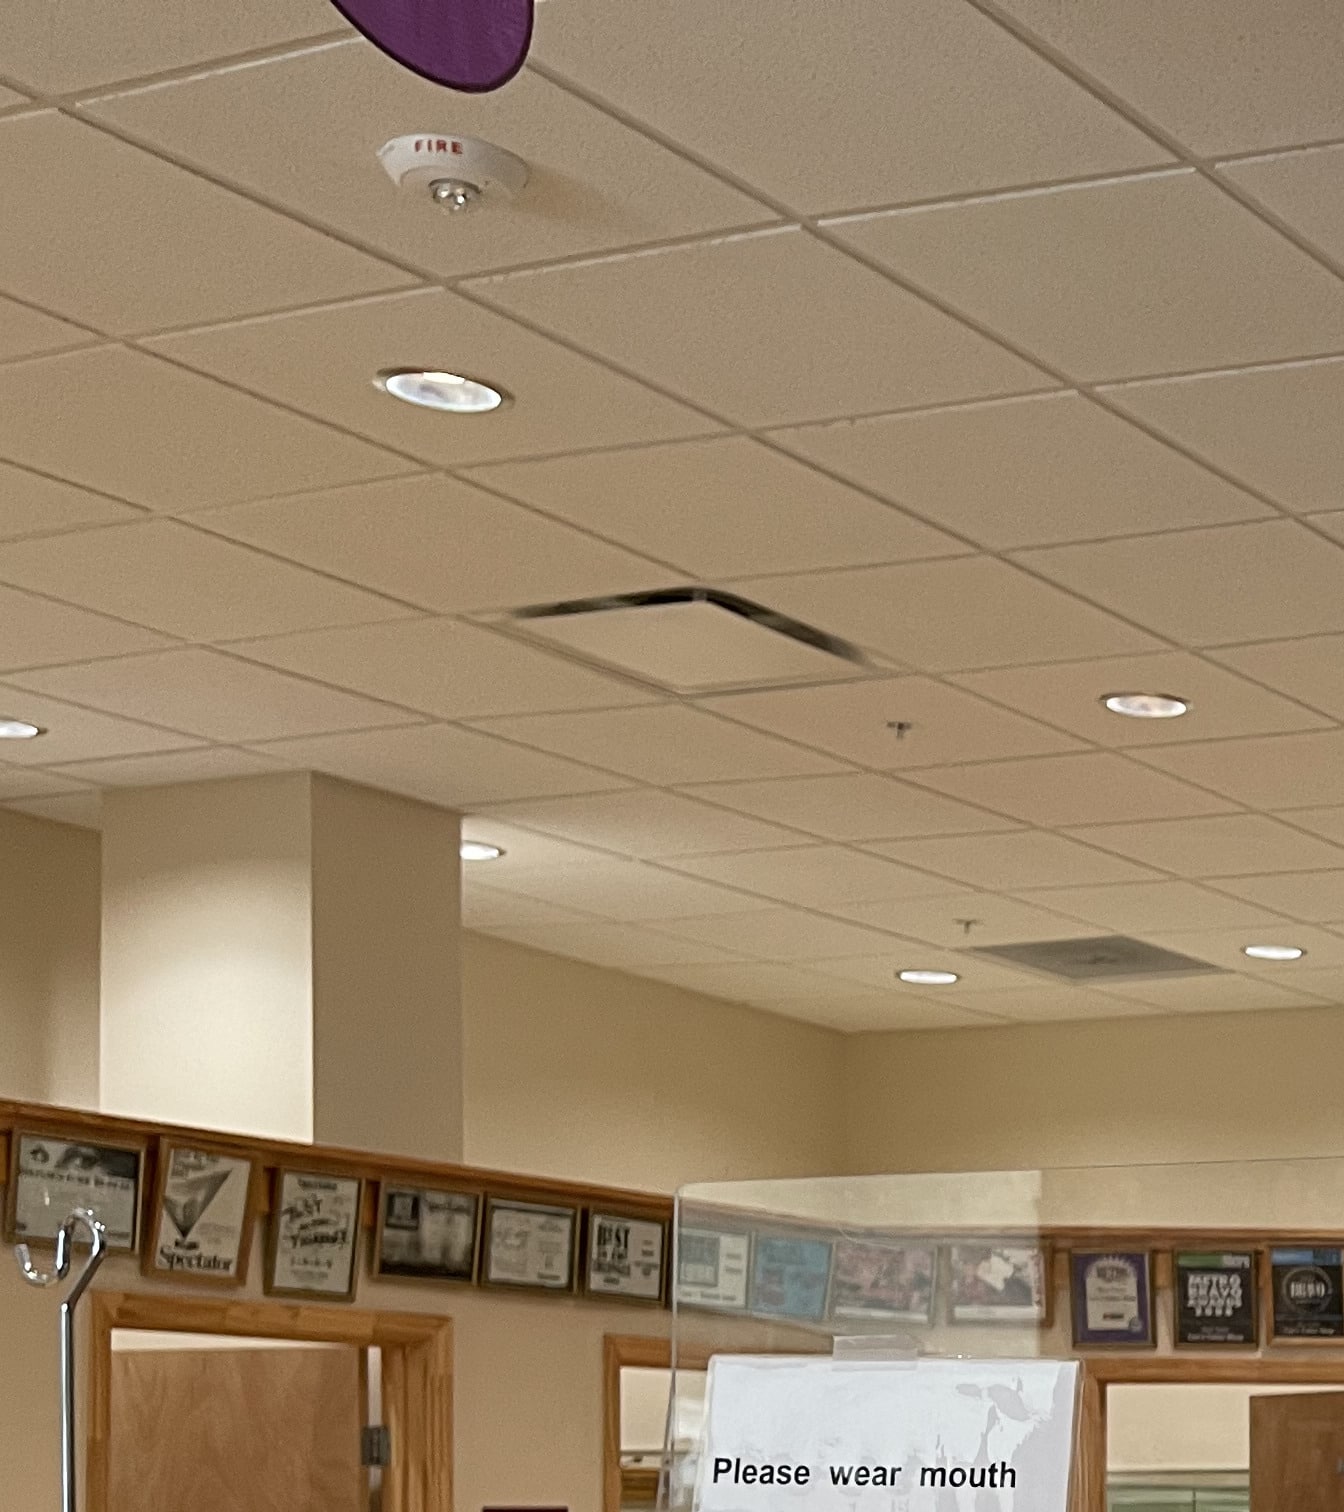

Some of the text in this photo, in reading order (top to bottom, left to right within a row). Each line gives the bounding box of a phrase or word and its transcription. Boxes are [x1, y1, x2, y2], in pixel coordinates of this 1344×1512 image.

[414, 139, 463, 155] FIRE
[712, 1457, 1018, 1489] Please wear mouth
